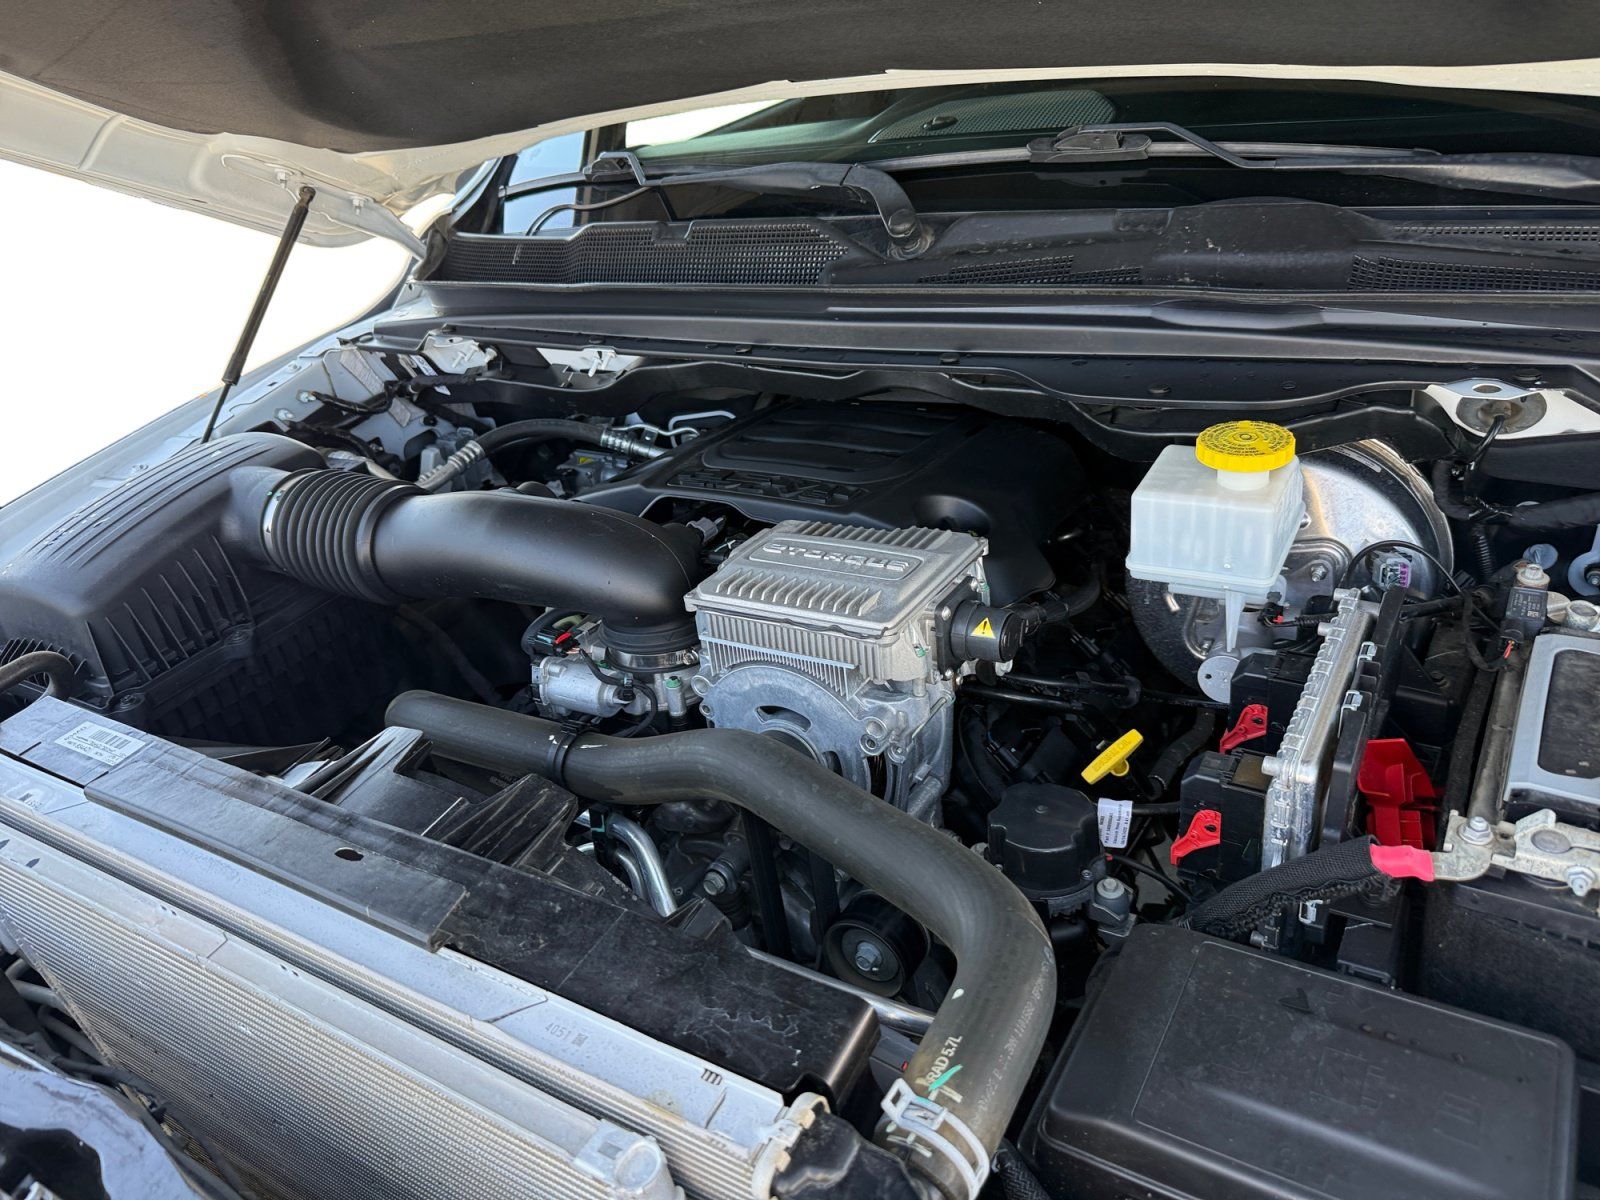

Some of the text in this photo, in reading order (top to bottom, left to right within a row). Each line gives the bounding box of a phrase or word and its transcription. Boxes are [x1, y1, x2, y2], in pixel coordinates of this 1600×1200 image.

[544, 1022, 572, 1041] 4051
[926, 1035, 964, 1083] RAD 5.7L
